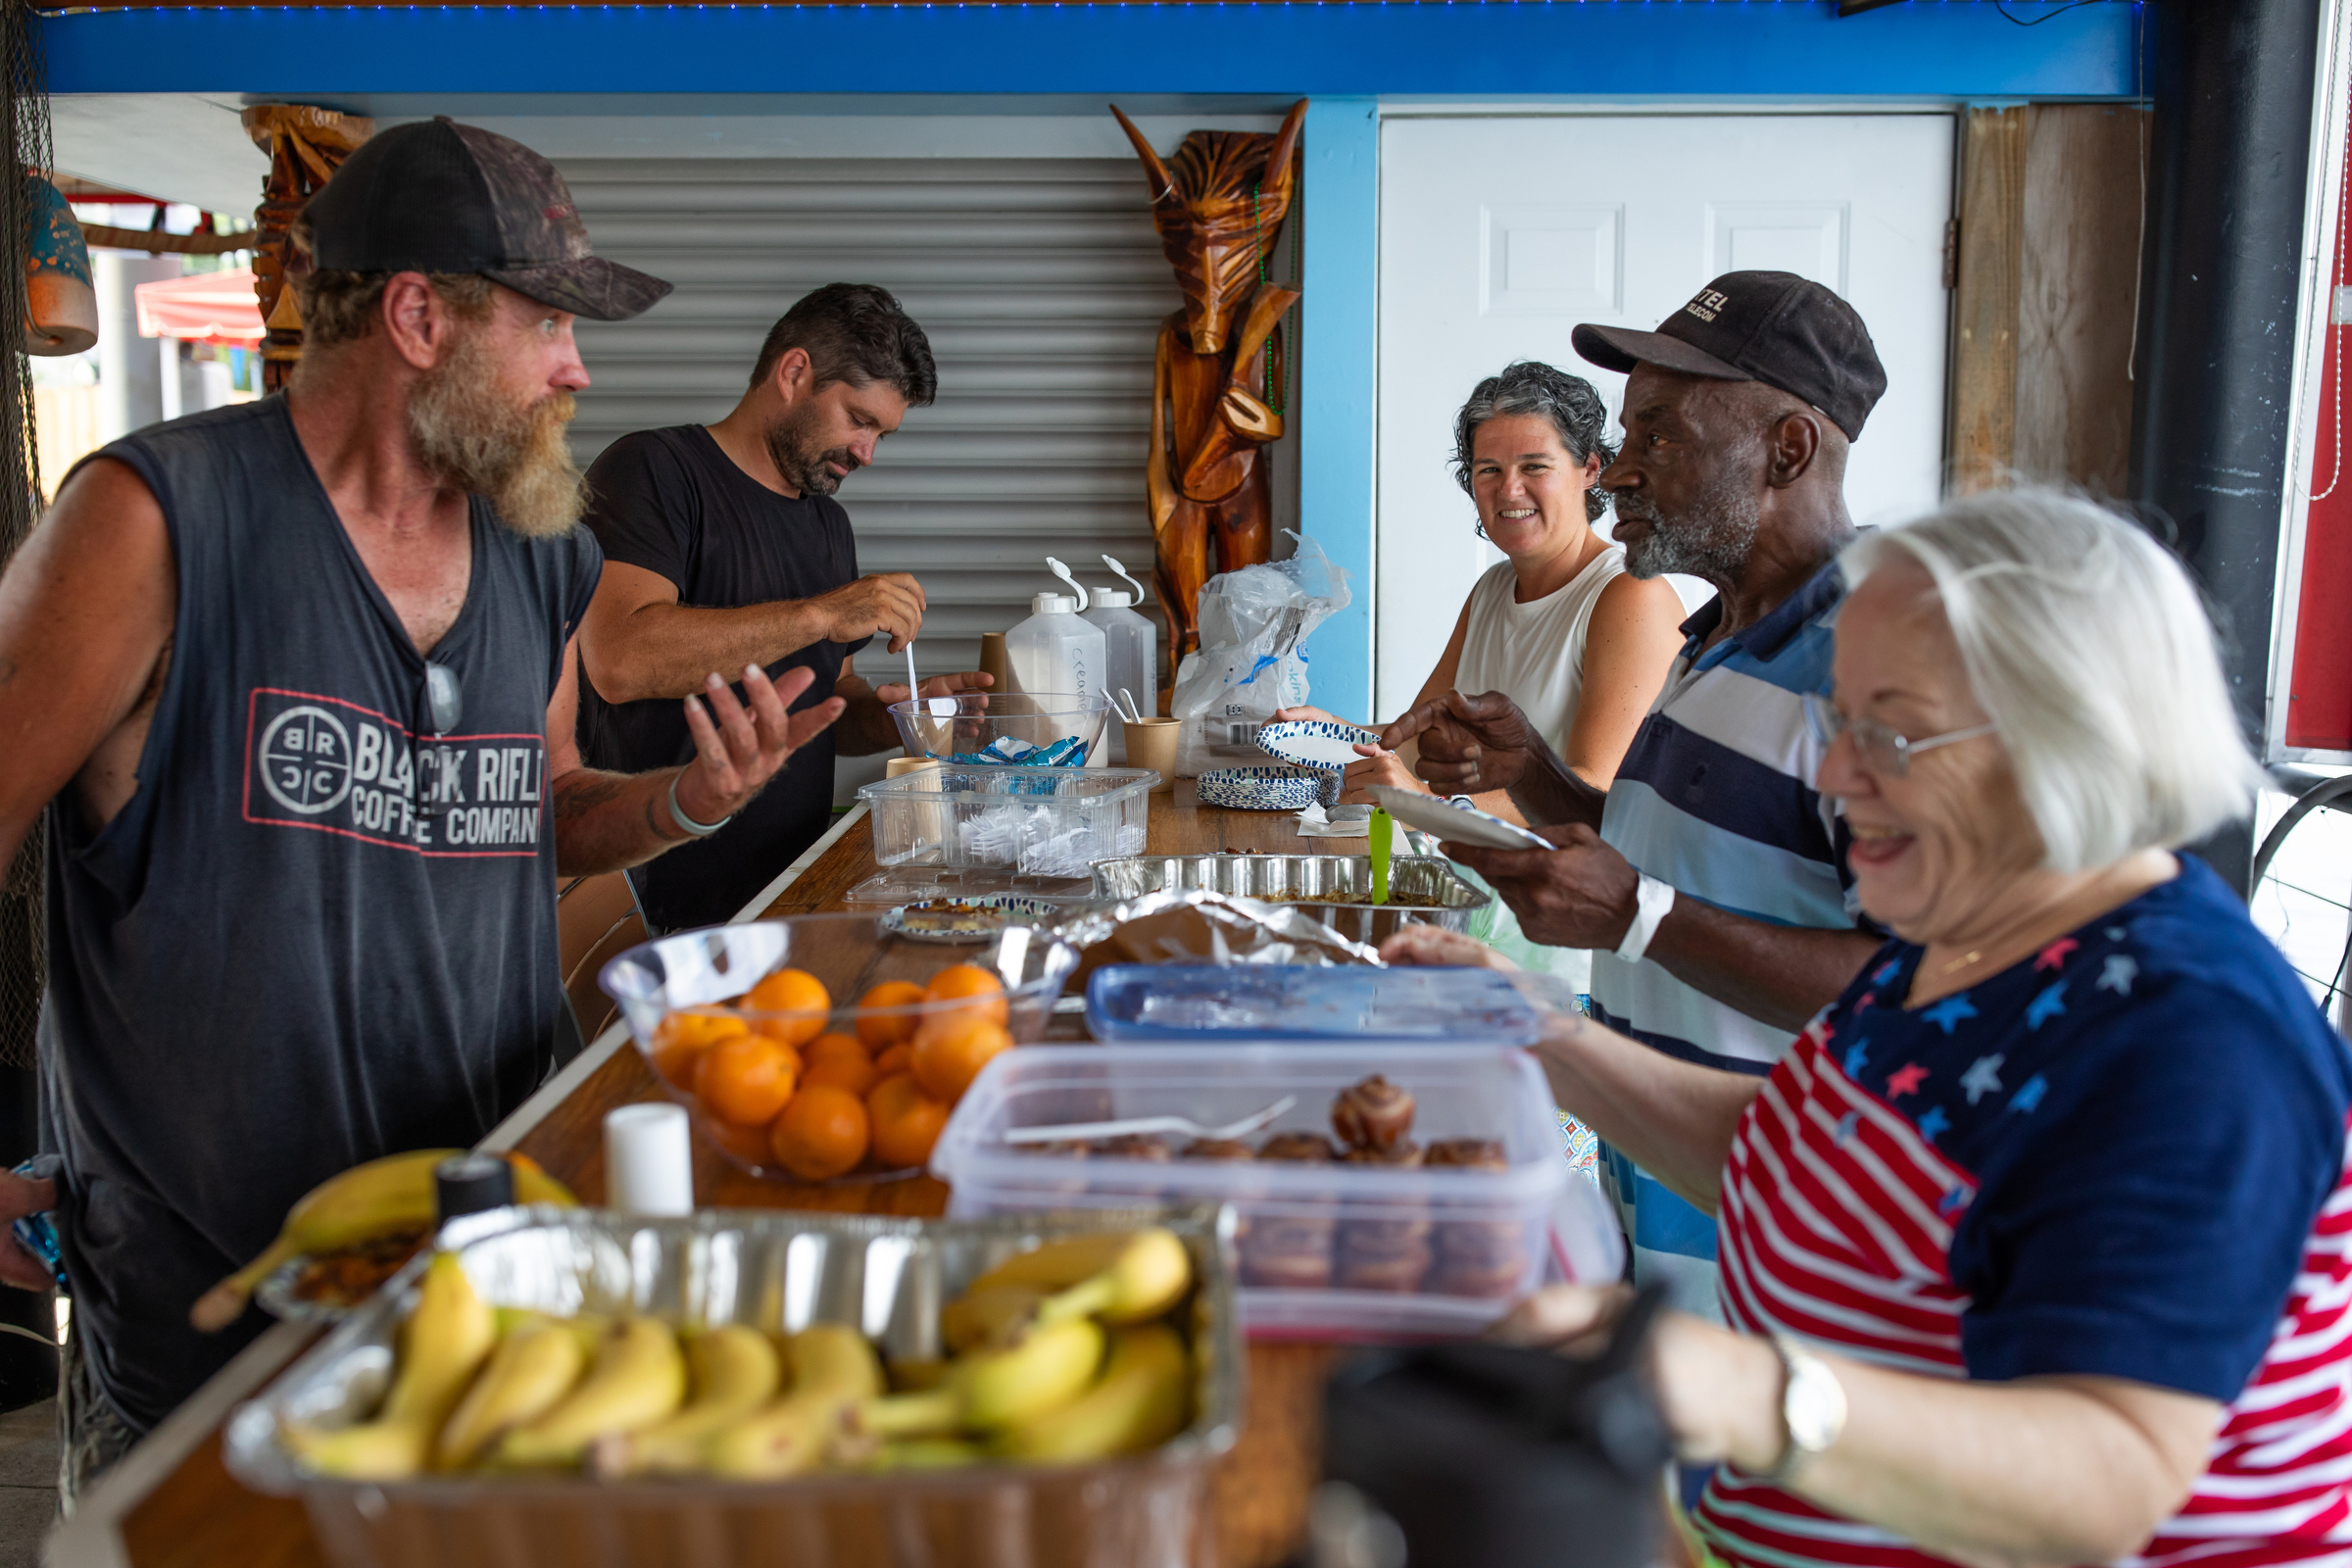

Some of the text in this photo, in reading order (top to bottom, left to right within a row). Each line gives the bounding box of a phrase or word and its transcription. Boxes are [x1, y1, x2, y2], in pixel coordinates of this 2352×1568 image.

[1287, 651, 1302, 705] apkins
[354, 721, 468, 803] BLACK
[351, 785, 541, 845] COFFE COMPAN
